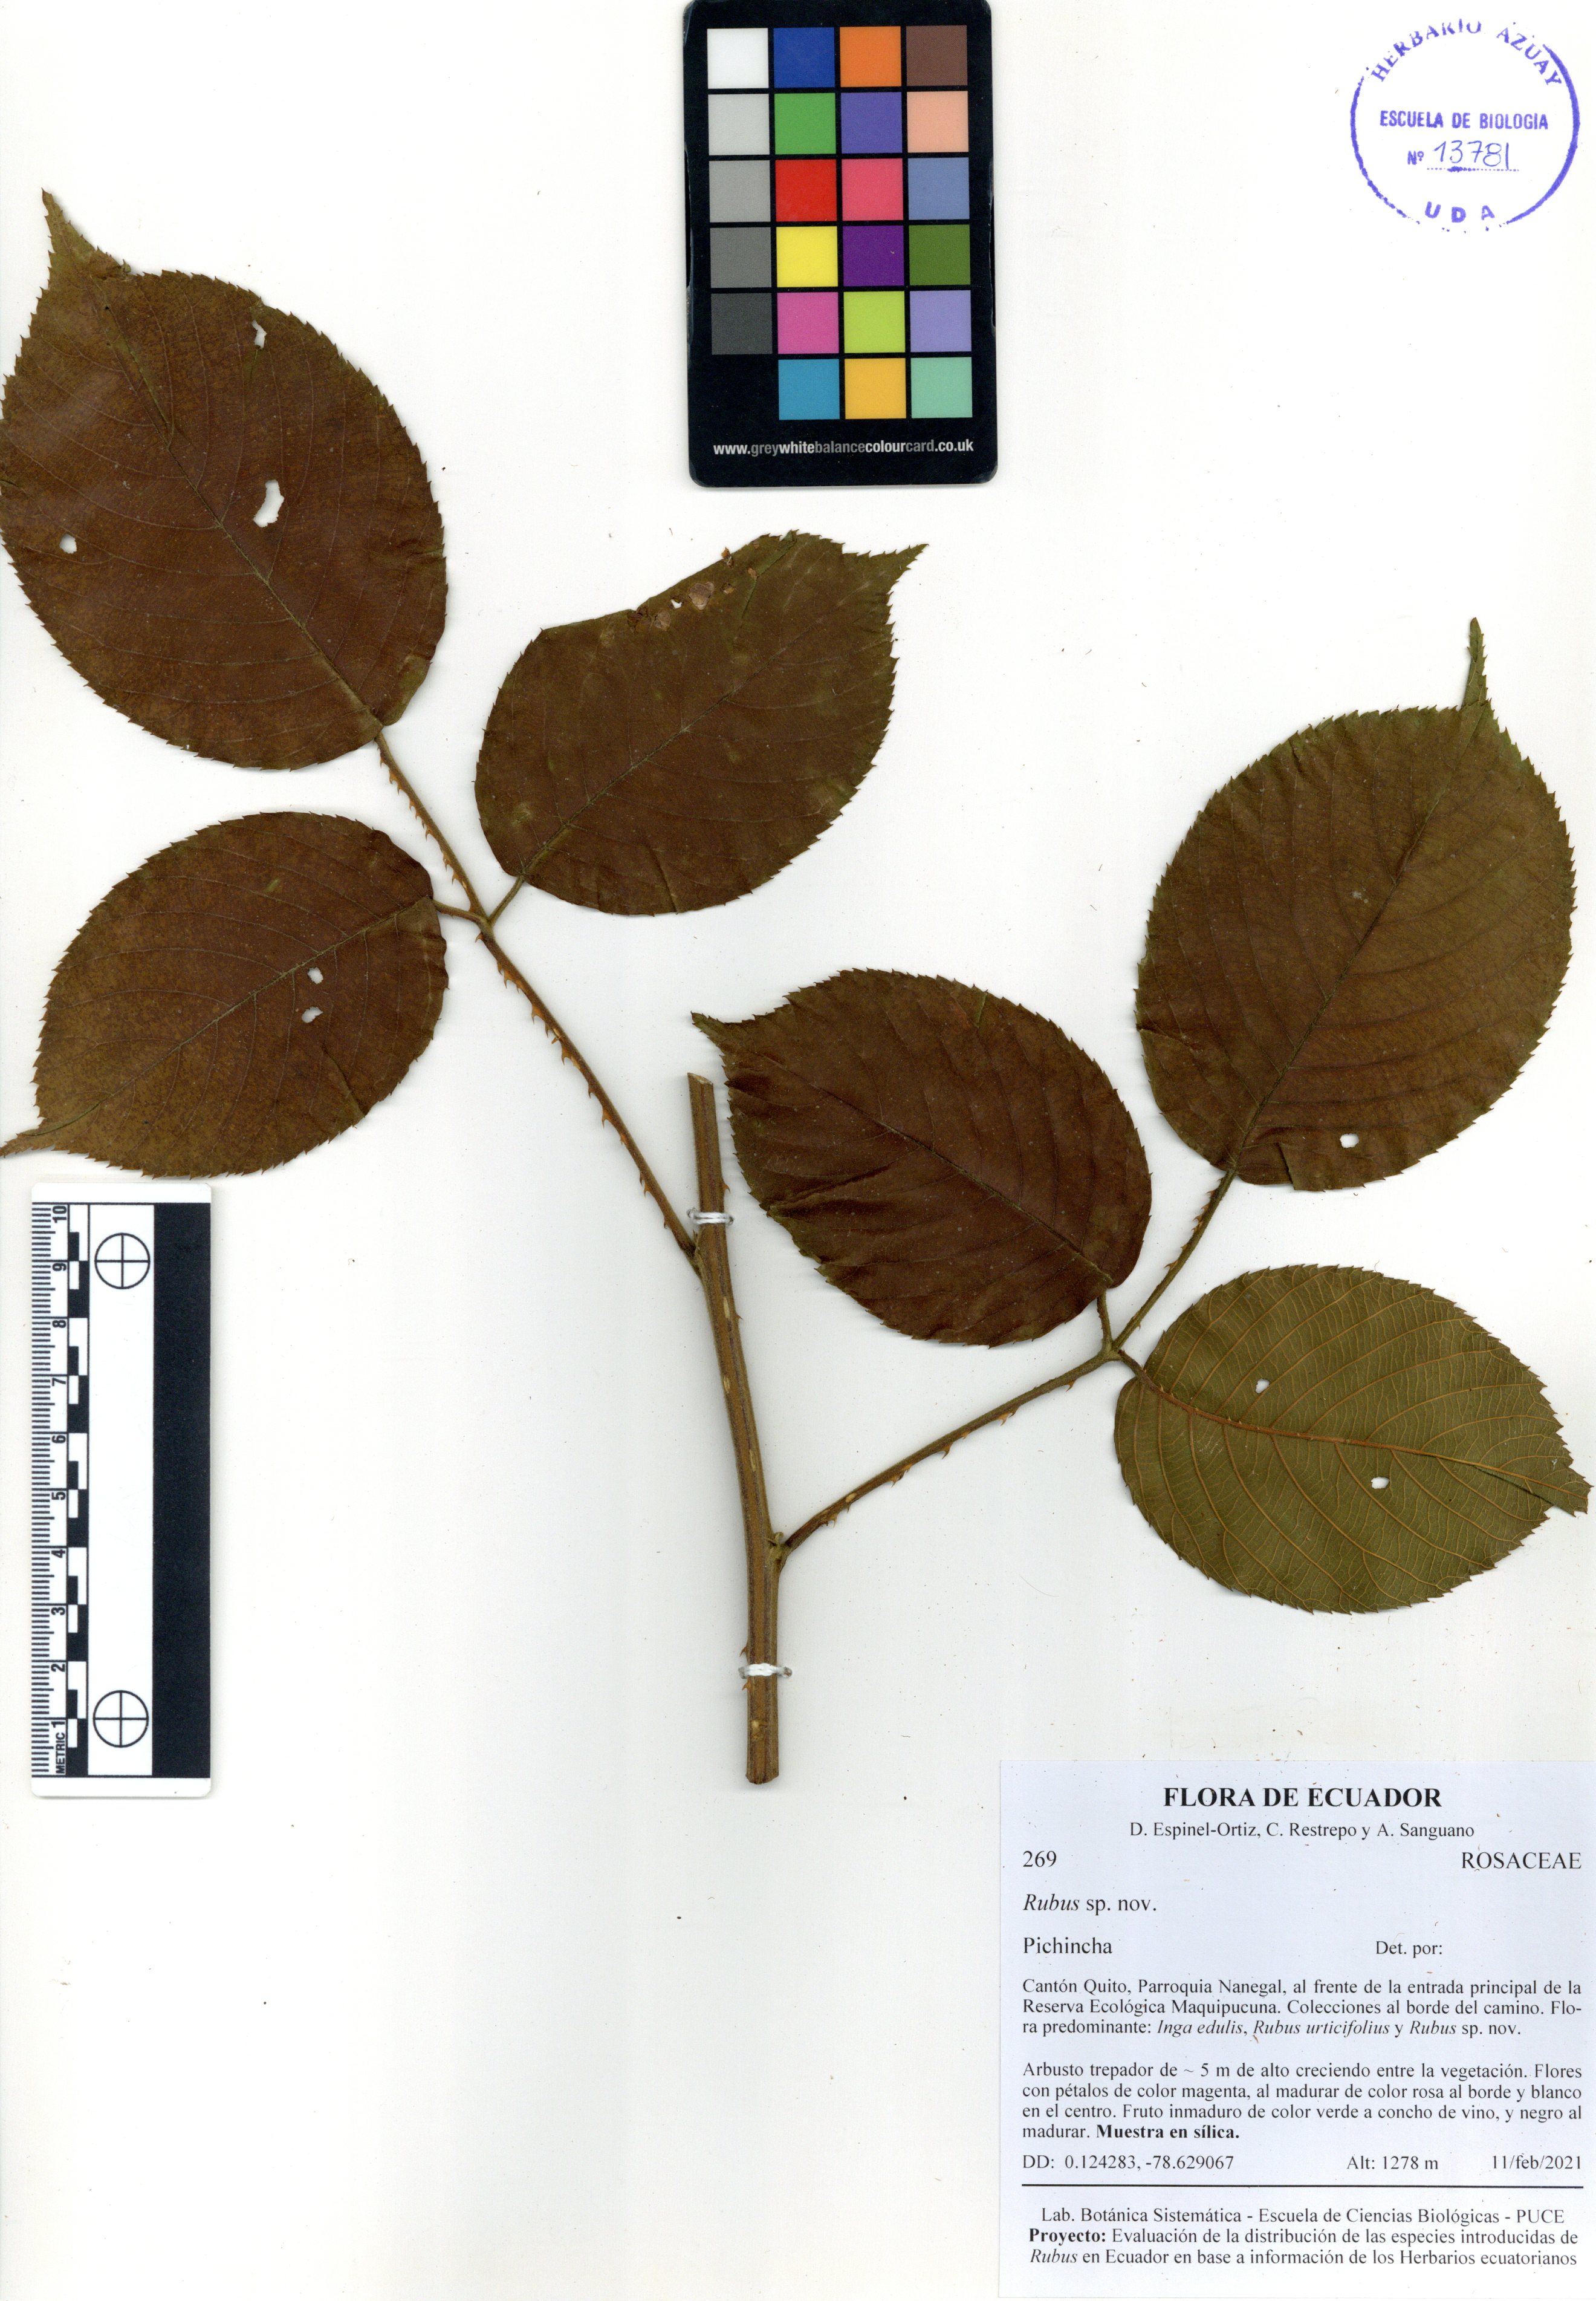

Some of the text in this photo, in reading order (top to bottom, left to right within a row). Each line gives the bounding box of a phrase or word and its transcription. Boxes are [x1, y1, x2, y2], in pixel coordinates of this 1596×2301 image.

[1496, 27, 1562, 86] AZUAY
[1380, 110, 1548, 129] ESCUELA DE BIOLOGIA
[1432, 140, 1510, 171] 13781
[713, 439, 974, 458] www.greywhitebalancecolourcard.co.uk
[52, 1206, 67, 1223] 10
[52, 1262, 67, 1272] 9
[52, 1320, 66, 1329] 8
[52, 1377, 66, 1387] 7
[51, 1434, 66, 1444] 6
[51, 1491, 66, 1500] 5
[51, 1549, 66, 1558] 4
[51, 1606, 66, 1616] 3
[51, 1663, 66, 1673] 2
[56, 1731, 66, 1775] METRIC
[1164, 1786, 1442, 1808] FLORA DE ECUADOR
[1130, 1821, 1474, 1841] D. Espinel-Ortiz, C. Restrepo y A. Sanguano
[1023, 1850, 1057, 1867] 269
[1462, 1852, 1581, 1870] ROSACEAE
[1023, 1893, 1156, 1916] Rubus sp. nov.
[1024, 1936, 1112, 1954] Pichincha
[1376, 1941, 1442, 1959] Det. por:
[1022, 1978, 1581, 1998] Cantón Quito, Parroquia Nanegal, al frente de la entrada principal de la
[1023, 1999, 1581, 2017] Reserva Ecológica Maquipucuna. Colecciones al borde del camino. Flo-
[1023, 2019, 1520, 2039] ra predominante: Inga edulis, Rubus urticifolius y Rubus sp. nov.
[1023, 2062, 1084, 2076] Arbusto
[1090, 2062, 1153, 2080] trepador
[1160, 2062, 1178, 2077] de
[1201, 2063, 1208, 2077] 5
[1216, 2066, 1230, 2077] m
[1236, 2062, 1254, 2077] de
[1260, 2062, 1289, 2077] alto
[1296, 2062, 1371, 2077] creciendo
[1377, 2065, 1415, 2077] entre
[1422, 2063, 1435, 2077] la
[1441, 2063, 1527, 2081] vegetación.
[1535, 2063, 1582, 2078] Flores
[1022, 2083, 1581, 2103] con pétalos de color magenta, al madurar de color rosa al borde y blanco
[1022, 2103, 1581, 2123] en el centro. Fruto inmaduro de color verde a concho de vino, y negro al
[1023, 2123, 1239, 2139] madurar. Muestra en sílica.
[1023, 2155, 1234, 2170] DD: 0.124283, -78.629067
[1347, 2155, 1438, 2170] Alt: 1278 m
[1493, 2155, 1580, 2169] 11/feb/2021
[1042, 2207, 1074, 2222] Lab.
[1082, 2207, 1148, 2222] Botánica
[1153, 2207, 1242, 2222] Sistemática
[1259, 2208, 1318, 2222] Escuela
[1323, 2208, 1341, 2222] de
[1346, 2208, 1412, 2222] Ciencias
[1418, 2208, 1499, 2227] Biológicas
[1517, 2209, 1564, 2224] PUCE
[1030, 2228, 1578, 2247] Proyecto: Evaluación de la distribución de las especies introducidas de
[1030, 2248, 1577, 2265] Rubus en Ecuador en base a información de los Herbarios ecuatorianos
